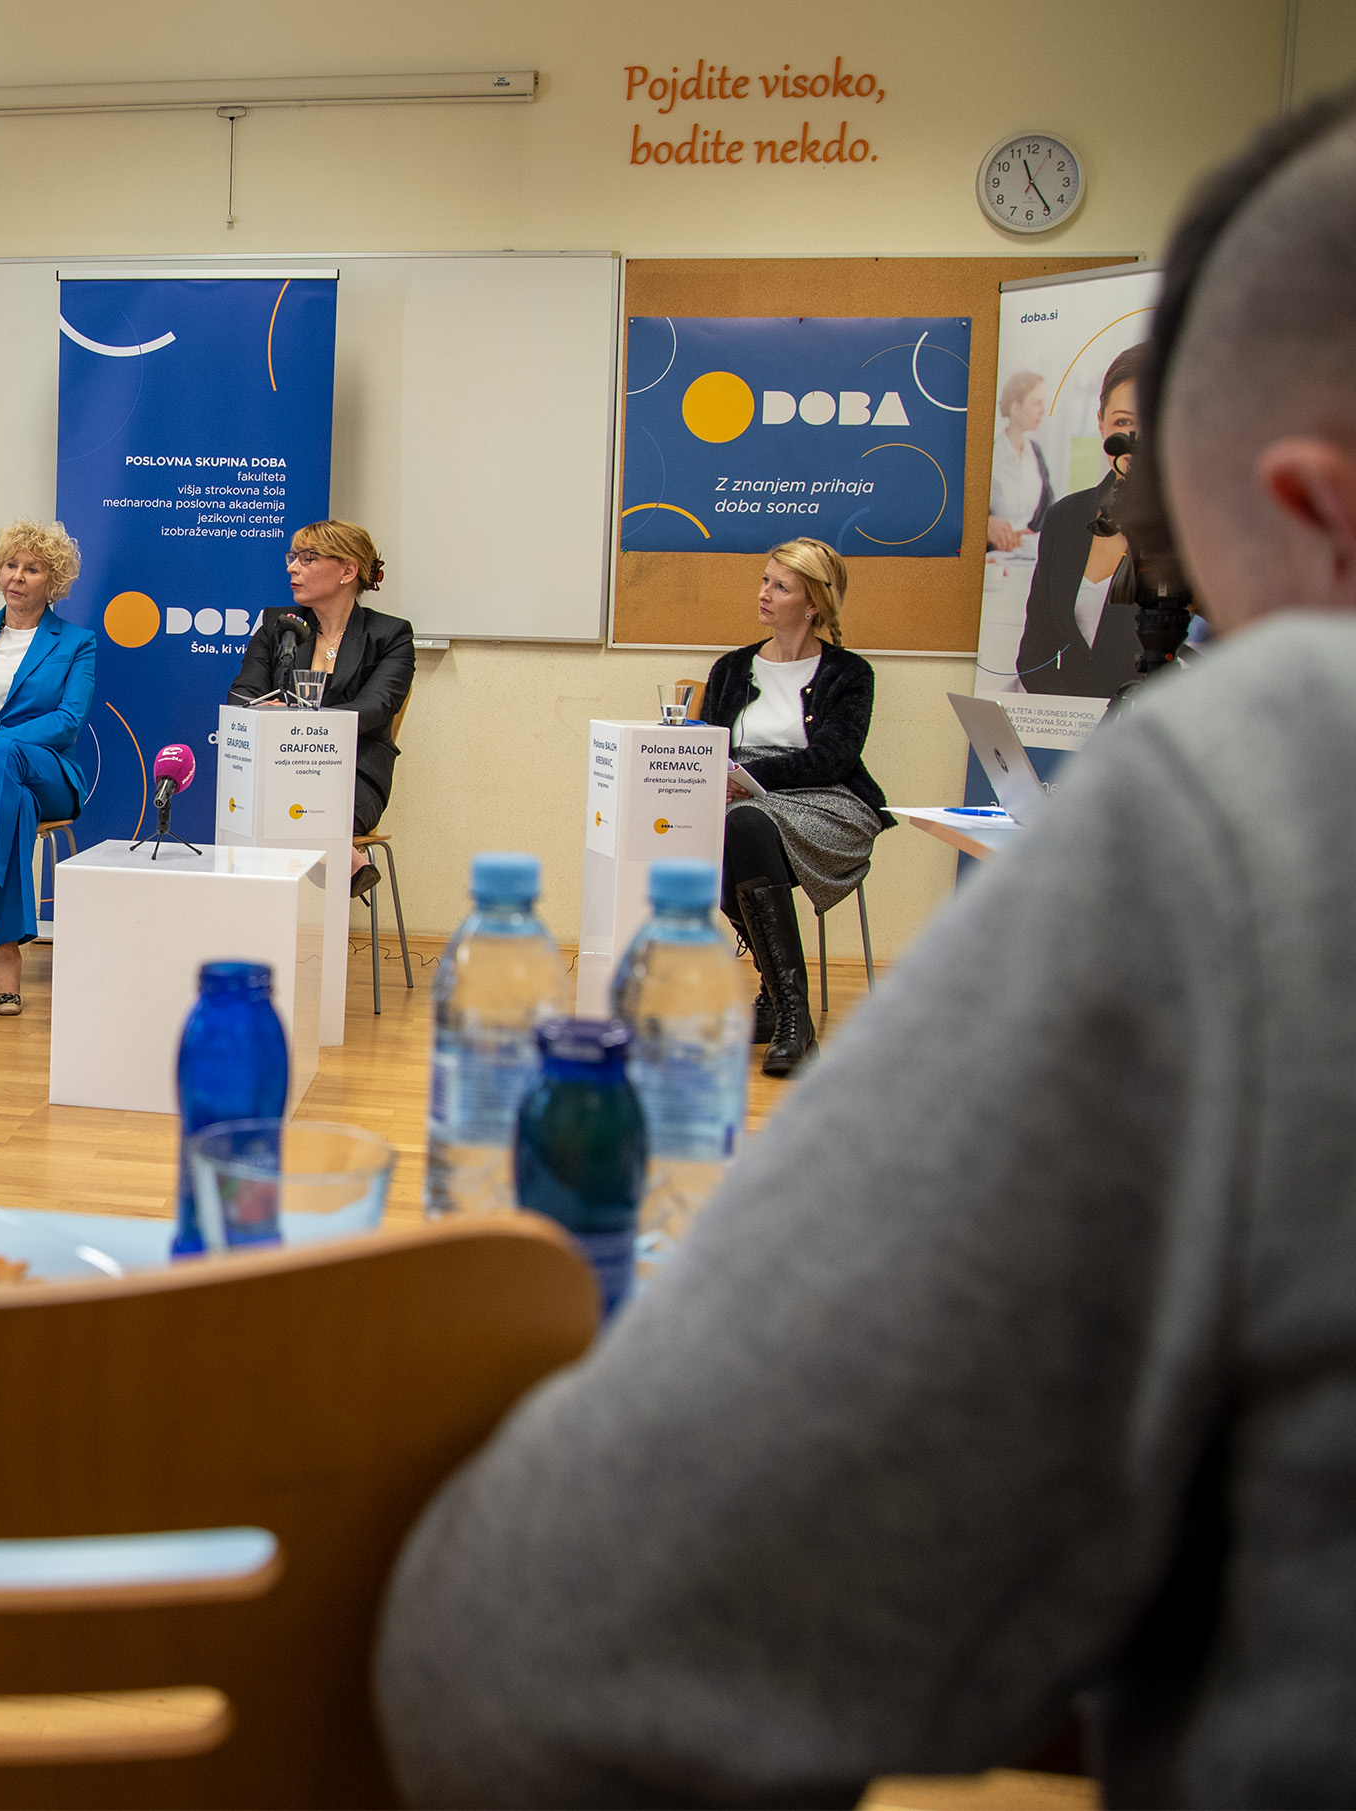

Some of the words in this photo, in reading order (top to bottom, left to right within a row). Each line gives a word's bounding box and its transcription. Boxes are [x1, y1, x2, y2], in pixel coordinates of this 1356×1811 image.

[624, 58, 750, 115] Pojdite
[758, 55, 885, 104] visoko,
[630, 123, 745, 166] bodite
[753, 121, 878, 163] nekdo.
[1026, 144, 1040, 154] 12
[1010, 148, 1022, 159] 11
[1047, 149, 1052, 159] 1
[997, 162, 1010, 172] 10
[1057, 161, 1065, 172] 2
[992, 178, 1000, 188] 9
[1062, 177, 1071, 187] 3
[996, 194, 1004, 205] 8
[1057, 194, 1065, 204] 4
[1010, 206, 1017, 216] 7
[1025, 210, 1034, 221] 6
[1020, 309, 1058, 323] doba.si
[762, 390, 910, 426] DOBA
[125, 456, 192, 467] POSLOVNA
[195, 457, 248, 467] SKUPINA
[251, 458, 287, 468] DOBA
[237, 471, 286, 482] fakulteta
[178, 485, 202, 497] višja
[205, 485, 260, 496] strokovna
[263, 486, 286, 496] šola
[715, 477, 729, 491] Z
[732, 478, 806, 495] znanjem
[810, 478, 874, 496] prihaja
[102, 498, 173, 509] mednarodna
[175, 499, 226, 511] poslovna
[228, 500, 285, 512] akademija
[714, 499, 761, 513] doba
[766, 503, 819, 514] sonca
[197, 513, 246, 525] jezikovni
[248, 515, 285, 524] center
[161, 526, 237, 539] izobraževanje
[240, 527, 284, 538] odraslih
[190, 641, 218, 655] Šola,
[222, 643, 232, 653] ki
[1037, 709, 1068, 717] BUSINESS
[1069, 712, 1095, 720] SCHOOL
[1015, 716, 1054, 726] STROKOVNA
[1056, 718, 1072, 727] ŠOLA
[290, 726, 304, 736] dr.
[306, 726, 329, 736] Daša
[1036, 727, 1080, 737] SAMOSTOJNO
[279, 744, 338, 754] GRAJFONER,
[641, 744, 676, 755] Polona
[678, 745, 713, 755] BALOH
[318, 759, 342, 767] poslovni
[649, 761, 703, 773] KREMAVC,
[677, 777, 706, 785] študijskih
